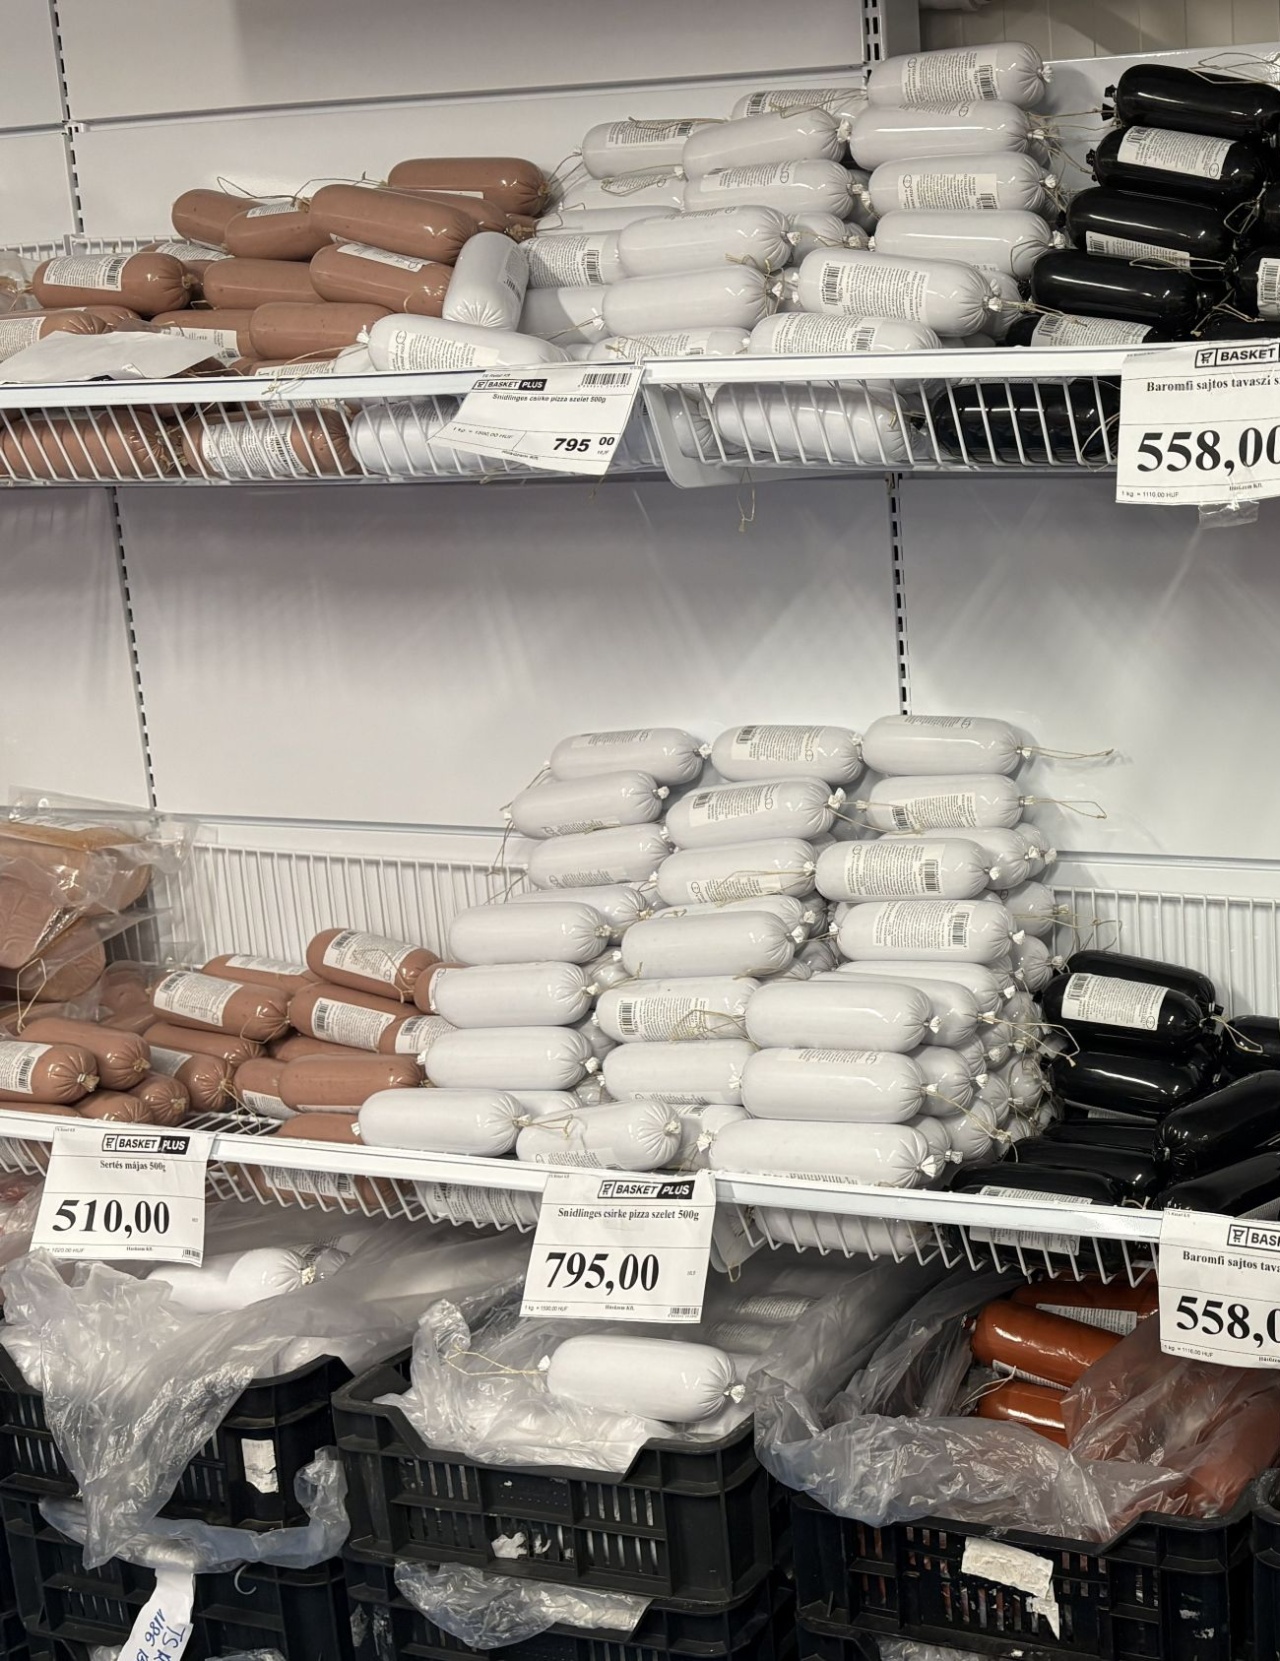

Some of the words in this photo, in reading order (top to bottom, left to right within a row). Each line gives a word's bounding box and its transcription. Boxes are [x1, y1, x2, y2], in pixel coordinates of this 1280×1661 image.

[1220, 348, 1276, 361] BASKET
[1146, 380, 1194, 392] Baromfi
[1196, 378, 1228, 393] sajtos
[1231, 375, 1271, 388] tavaszi
[553, 438, 591, 452] 795
[599, 437, 615, 446] 00
[118, 1139, 157, 1149] BASKET
[162, 1141, 186, 1150] PLUS
[100, 1160, 123, 1170] Sertés
[125, 1162, 148, 1172] májas
[149, 1163, 166, 1172] 500g
[616, 1185, 658, 1195] BASKET
[662, 1185, 690, 1195] PLUS
[52, 1199, 170, 1239] 510,00
[558, 1208, 602, 1219] Snidlinges
[603, 1209, 627, 1218] csirke
[629, 1210, 650, 1220] pizza
[651, 1210, 676, 1219] szelet
[678, 1210, 699, 1220] 500g
[1182, 1250, 1225, 1266] Baromfi
[1227, 1256, 1258, 1270] sajtos
[545, 1252, 660, 1296] 795,00
[144, 1608, 166, 1646] 1186
